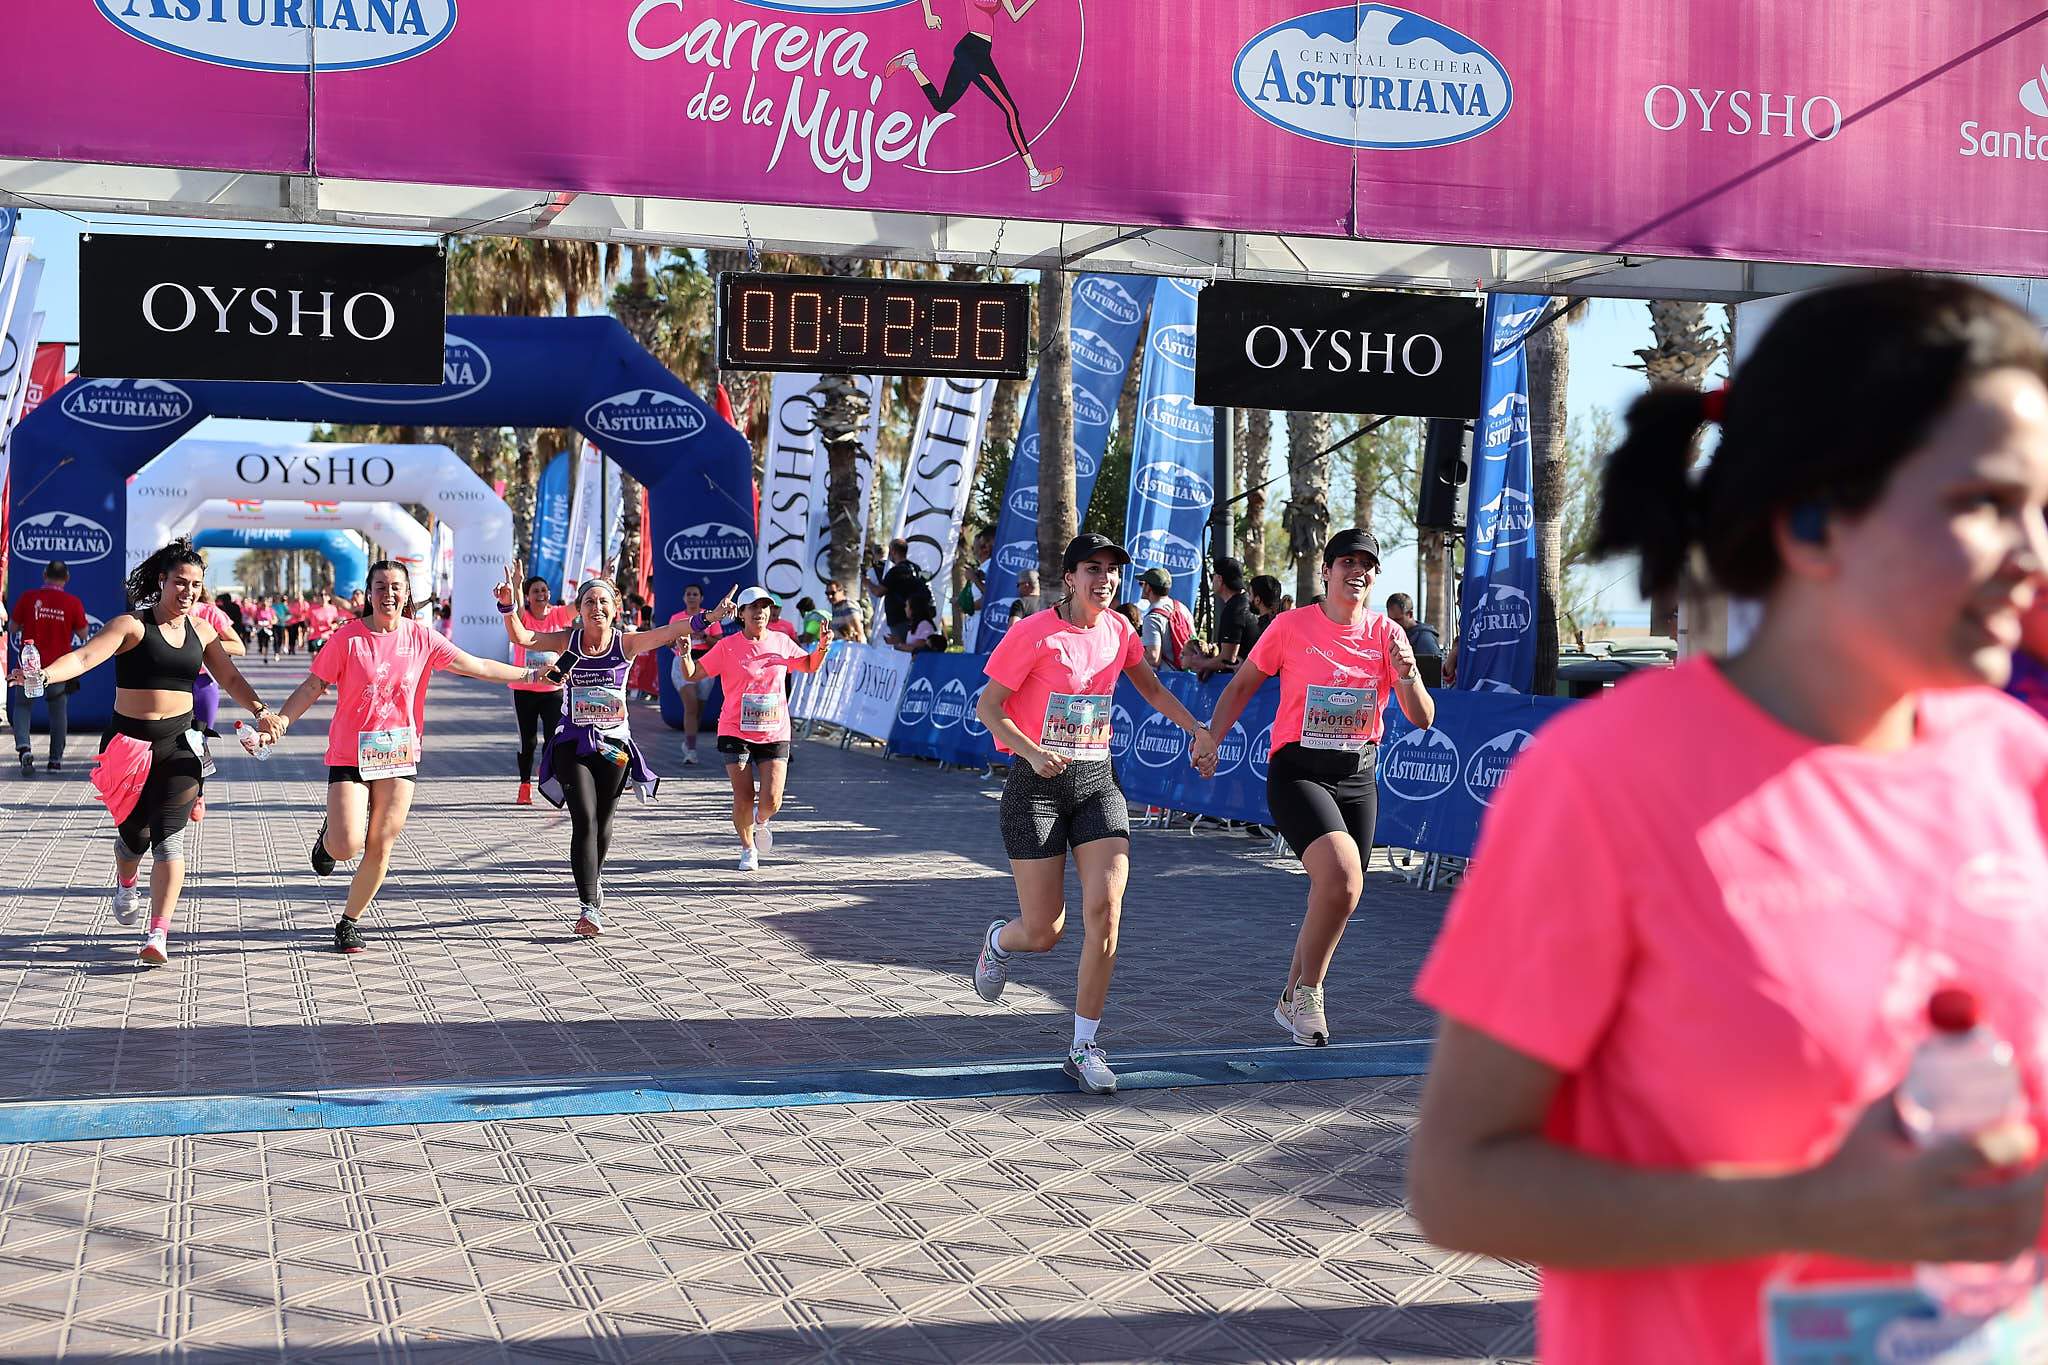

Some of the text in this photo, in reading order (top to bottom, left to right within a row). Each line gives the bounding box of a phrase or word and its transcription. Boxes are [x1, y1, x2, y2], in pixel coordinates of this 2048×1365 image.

[121, 0, 430, 36] TURIANA
[627, 0, 870, 80] Carrera
[1299, 49, 1483, 76] CENTRAL LECHERA
[1255, 49, 1492, 117] ASTURIANA
[1643, 84, 1843, 141] OYSHO
[686, 71, 957, 193] de la Mujer
[142, 282, 395, 341] OYSHO
[1082, 282, 1135, 321] ASTURIANA
[742, 290, 1006, 361] 00:42:36
[1245, 324, 1443, 377] OYSHO
[69, 392, 182, 417] ASTURIANA
[596, 410, 699, 431] ASTURIANA
[1148, 403, 1213, 436] ASTURIAN
[236, 453, 394, 487] OYSHO
[138, 487, 188, 497] OYSHO
[438, 491, 485, 500] OYSHO
[764, 394, 820, 600] OYSHO
[1139, 472, 1207, 503] ASTURIANA
[16, 530, 105, 552] ASTURIANA
[671, 541, 751, 561] ASTURIANA
[1137, 729, 1181, 754] ASTURIANA
[1387, 750, 1451, 783] ASTURIANA
